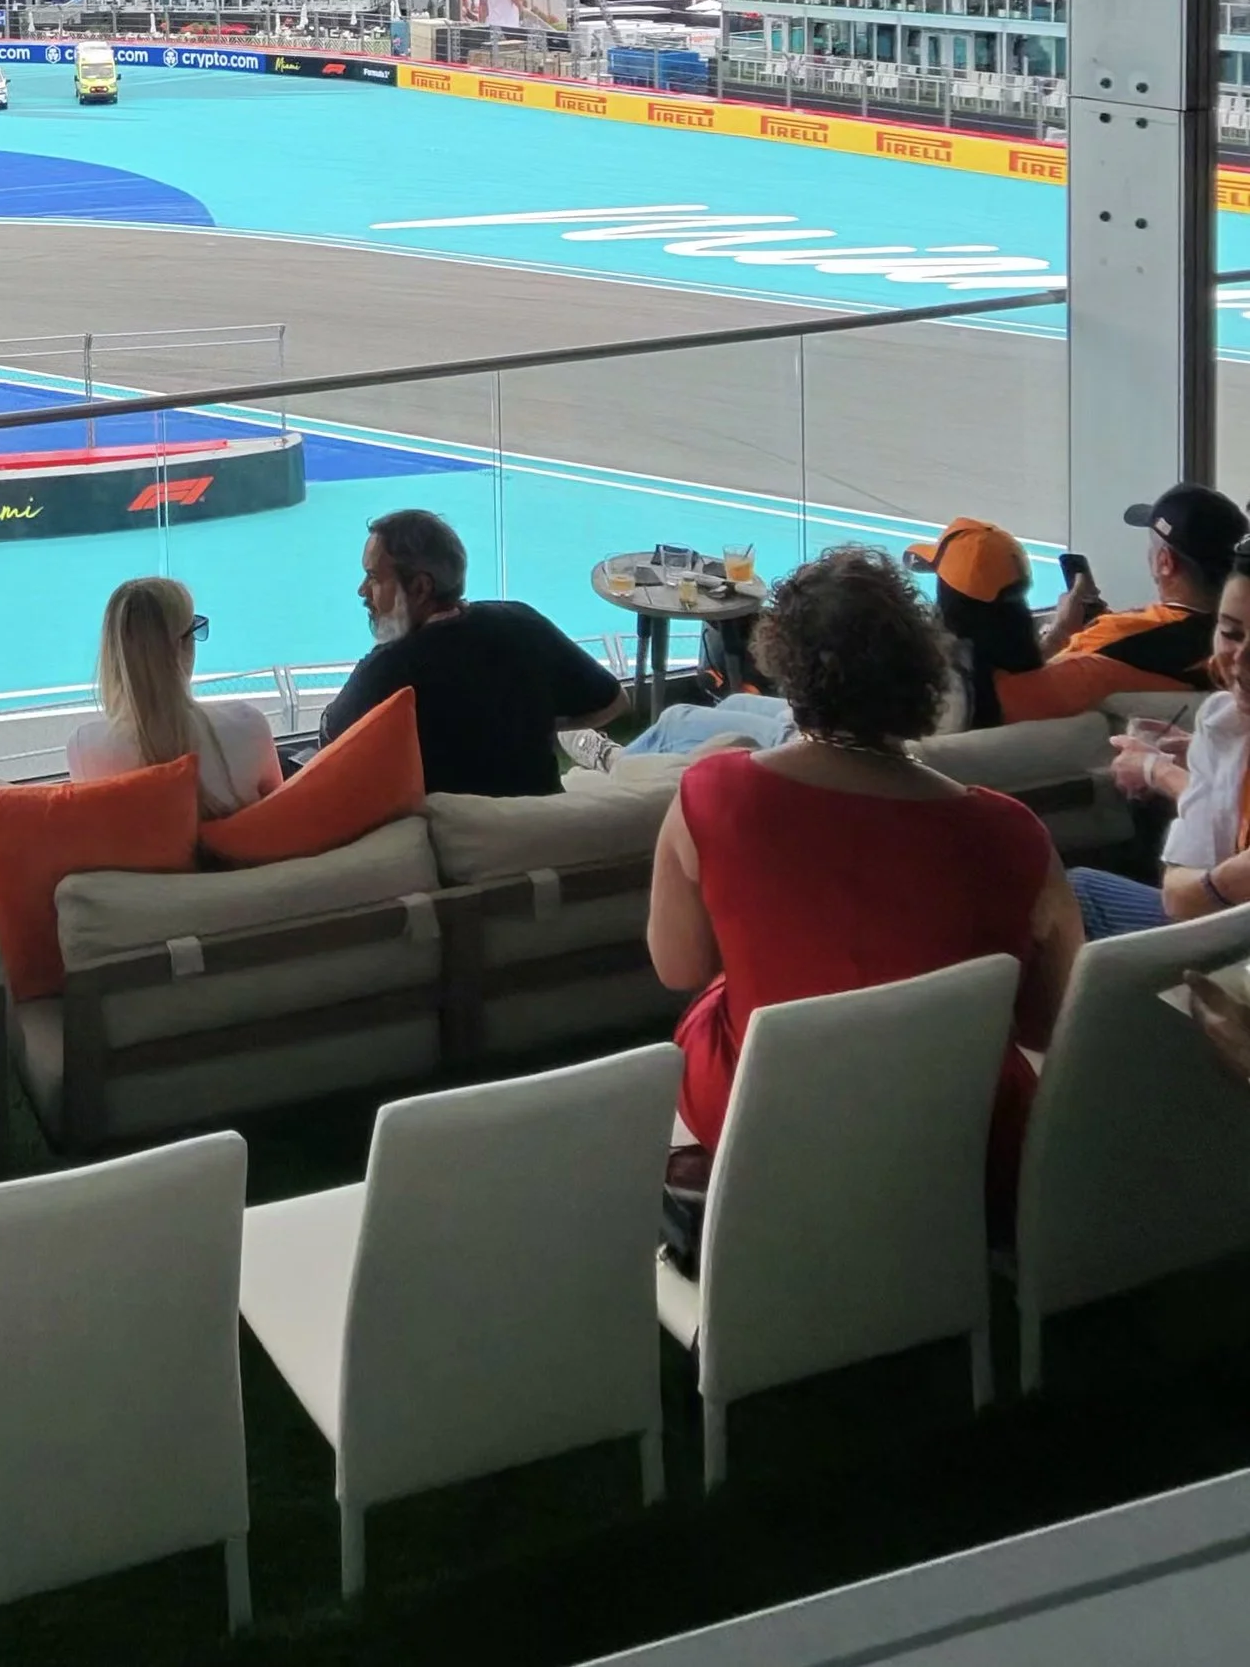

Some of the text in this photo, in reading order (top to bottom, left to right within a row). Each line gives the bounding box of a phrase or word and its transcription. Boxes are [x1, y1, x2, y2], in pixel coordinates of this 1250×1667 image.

[182, 51, 259, 69] crypto.com
[411, 70, 451, 92] PIRELLI
[479, 80, 524, 103] PIRELLI
[555, 91, 607, 115] PIRELLI
[648, 102, 715, 128] PIRELLI
[761, 115, 829, 143] PIRELLI
[876, 131, 953, 162] PIRELLI
